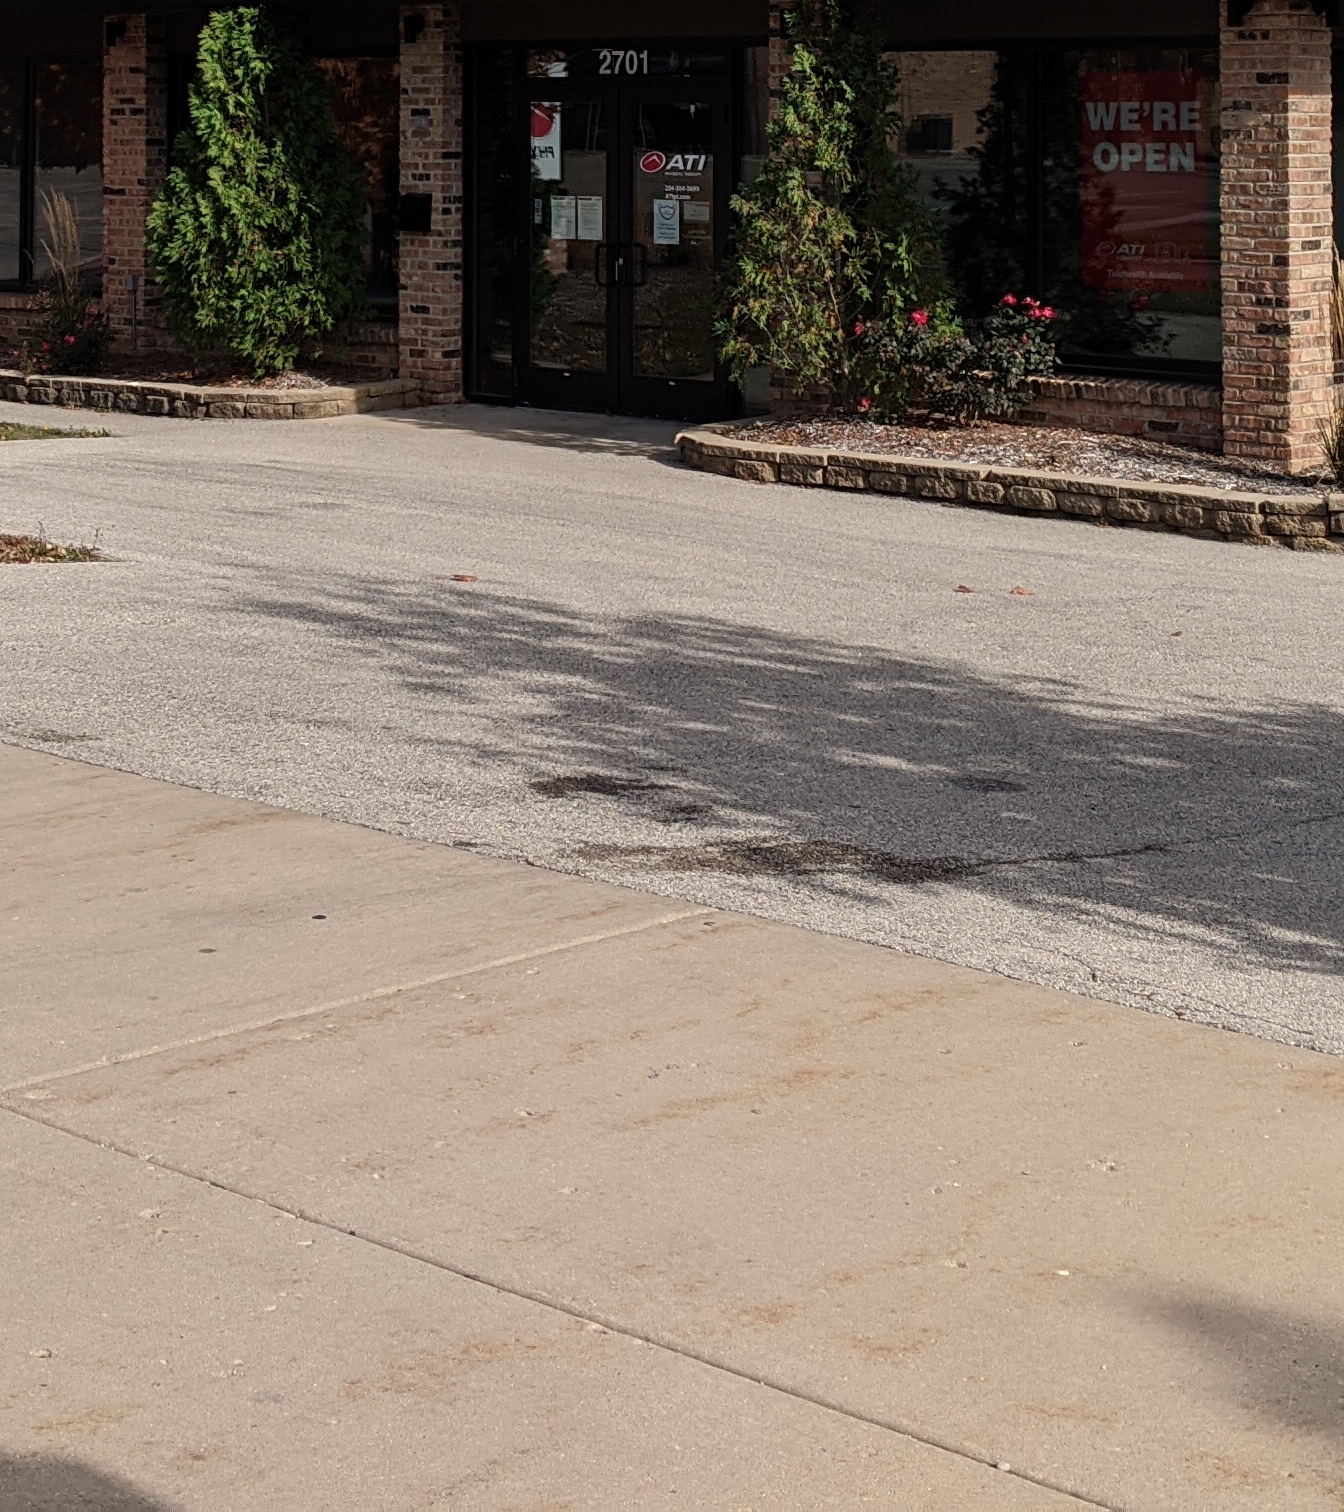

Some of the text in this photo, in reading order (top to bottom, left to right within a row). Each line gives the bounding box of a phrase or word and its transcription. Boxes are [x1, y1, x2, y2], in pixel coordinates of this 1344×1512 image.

[599, 50, 648, 75] 2701
[1086, 101, 1202, 131] WE'RE
[666, 154, 706, 171] ATI
[1093, 142, 1195, 173] OPEN
[1116, 244, 1145, 255] ATI
